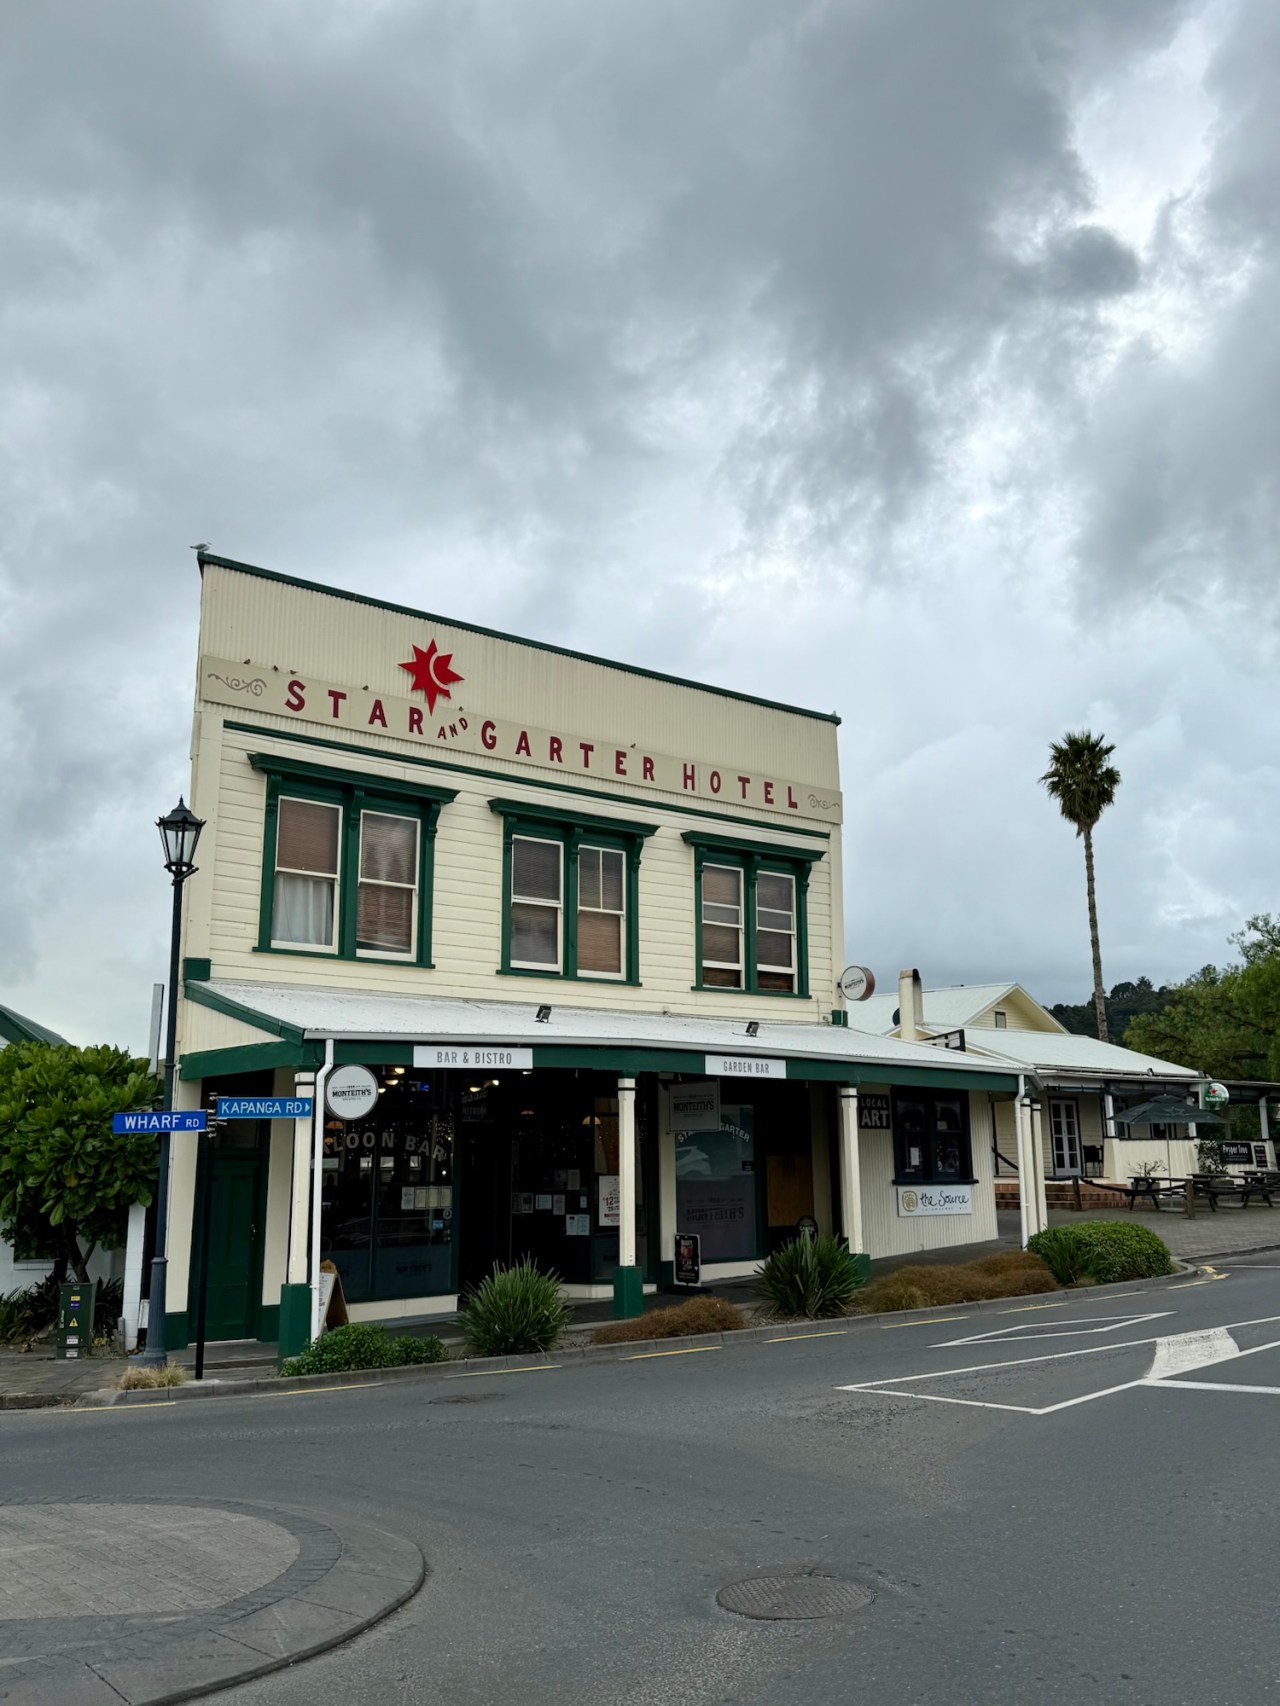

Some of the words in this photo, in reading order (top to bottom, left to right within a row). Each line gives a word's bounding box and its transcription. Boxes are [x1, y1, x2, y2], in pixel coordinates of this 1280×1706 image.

[285, 680, 423, 735] STAR
[437, 717, 468, 740] AND
[481, 720, 655, 781] GARTER
[683, 763, 798, 809] HOTEL
[437, 1051, 457, 1064] BAR
[463, 1052, 469, 1064] &
[475, 1052, 512, 1065] BISTRO
[723, 1061, 752, 1073] GARDEN
[755, 1063, 769, 1074] BAR
[332, 1088, 371, 1098] MONTEITH'S
[221, 1101, 282, 1115] KAPANGA
[285, 1101, 303, 1114] RD
[673, 1101, 714, 1112] MONTEITH'S
[861, 1098, 887, 1108] LOCAL
[124, 1114, 181, 1130] WHARF
[185, 1118, 200, 1129] RD
[861, 1109, 889, 1127] ART
[405, 1135, 446, 1162] BAR
[920, 1192, 937, 1207] the
[938, 1190, 969, 1207] Source
